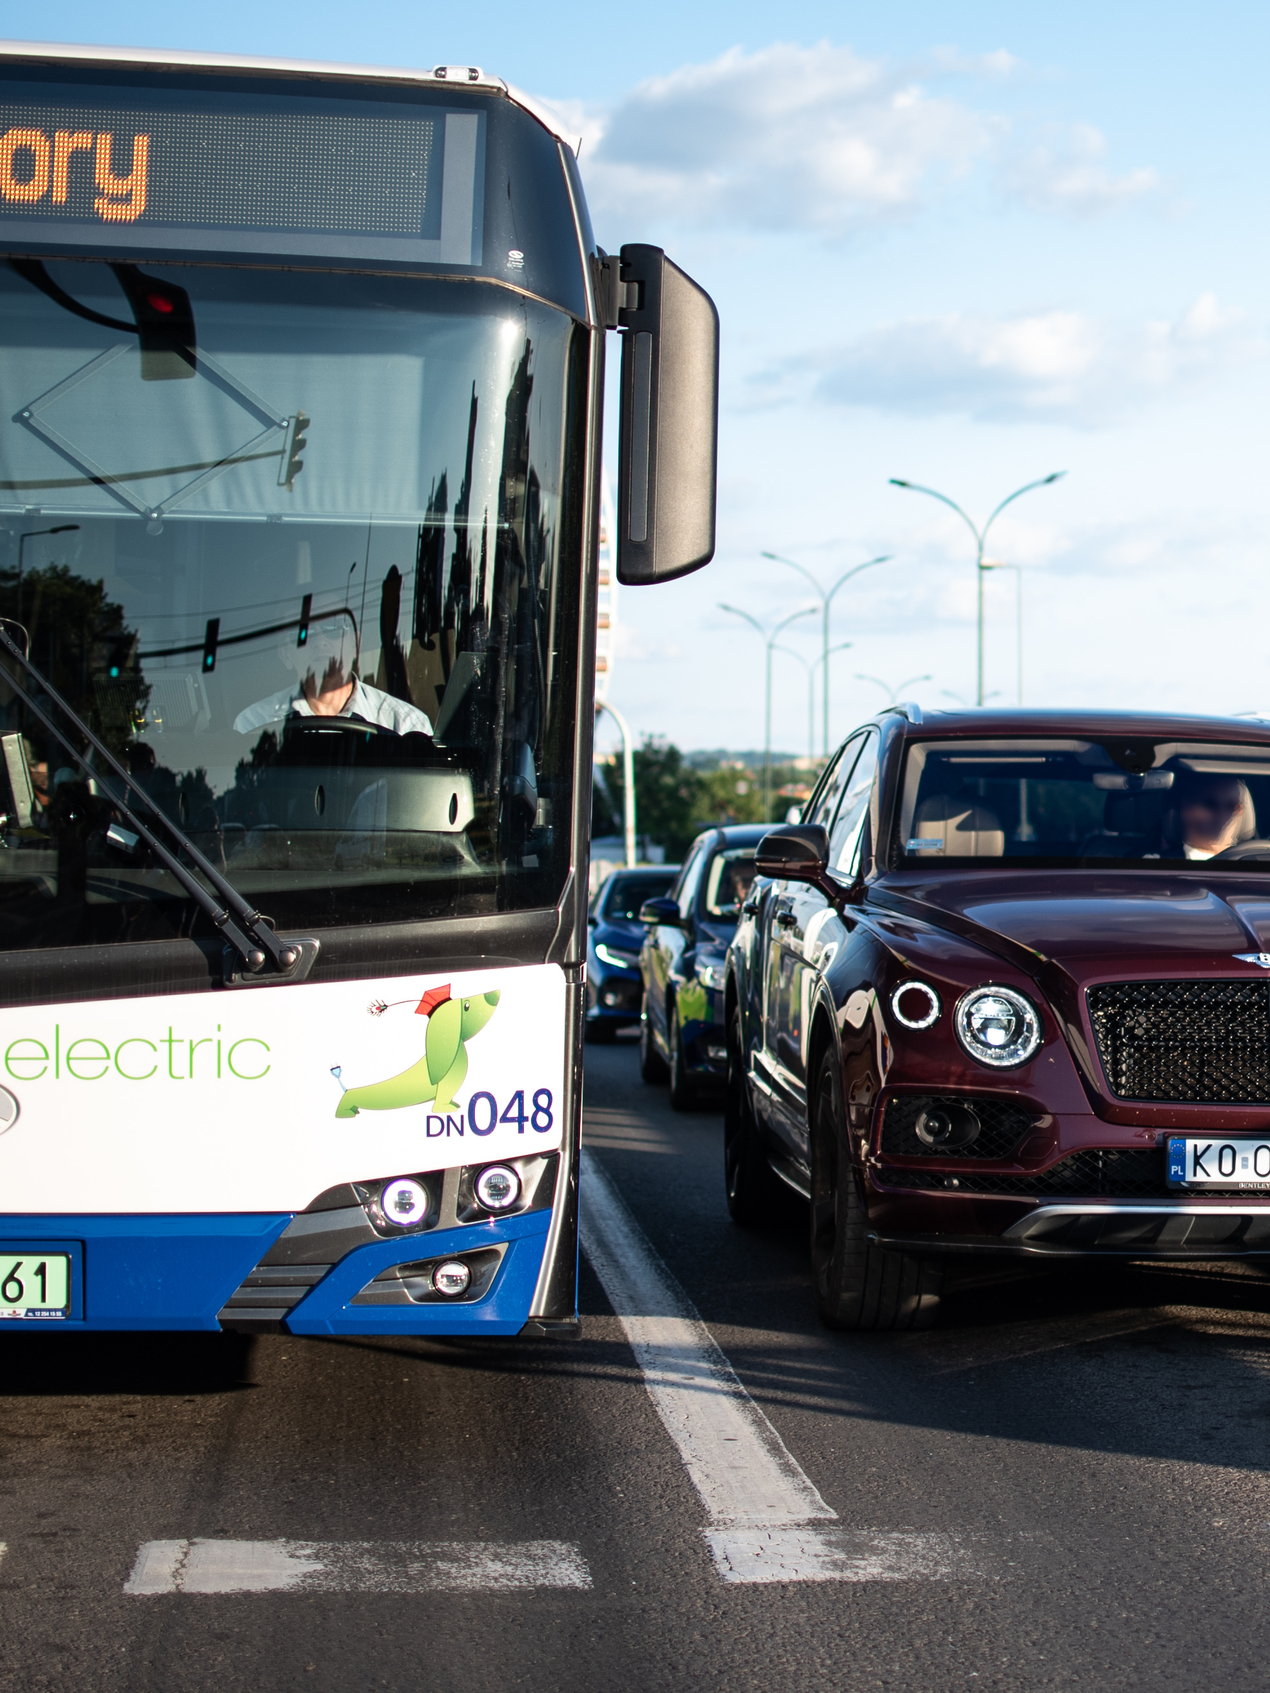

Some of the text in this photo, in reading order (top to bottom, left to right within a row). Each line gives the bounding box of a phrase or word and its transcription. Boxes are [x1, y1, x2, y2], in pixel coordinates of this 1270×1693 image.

[0, 126, 150, 223] ory
[5, 1023, 271, 1081] electric
[1171, 1166, 1184, 1176] PL
[1, 1261, 47, 1304] 61
